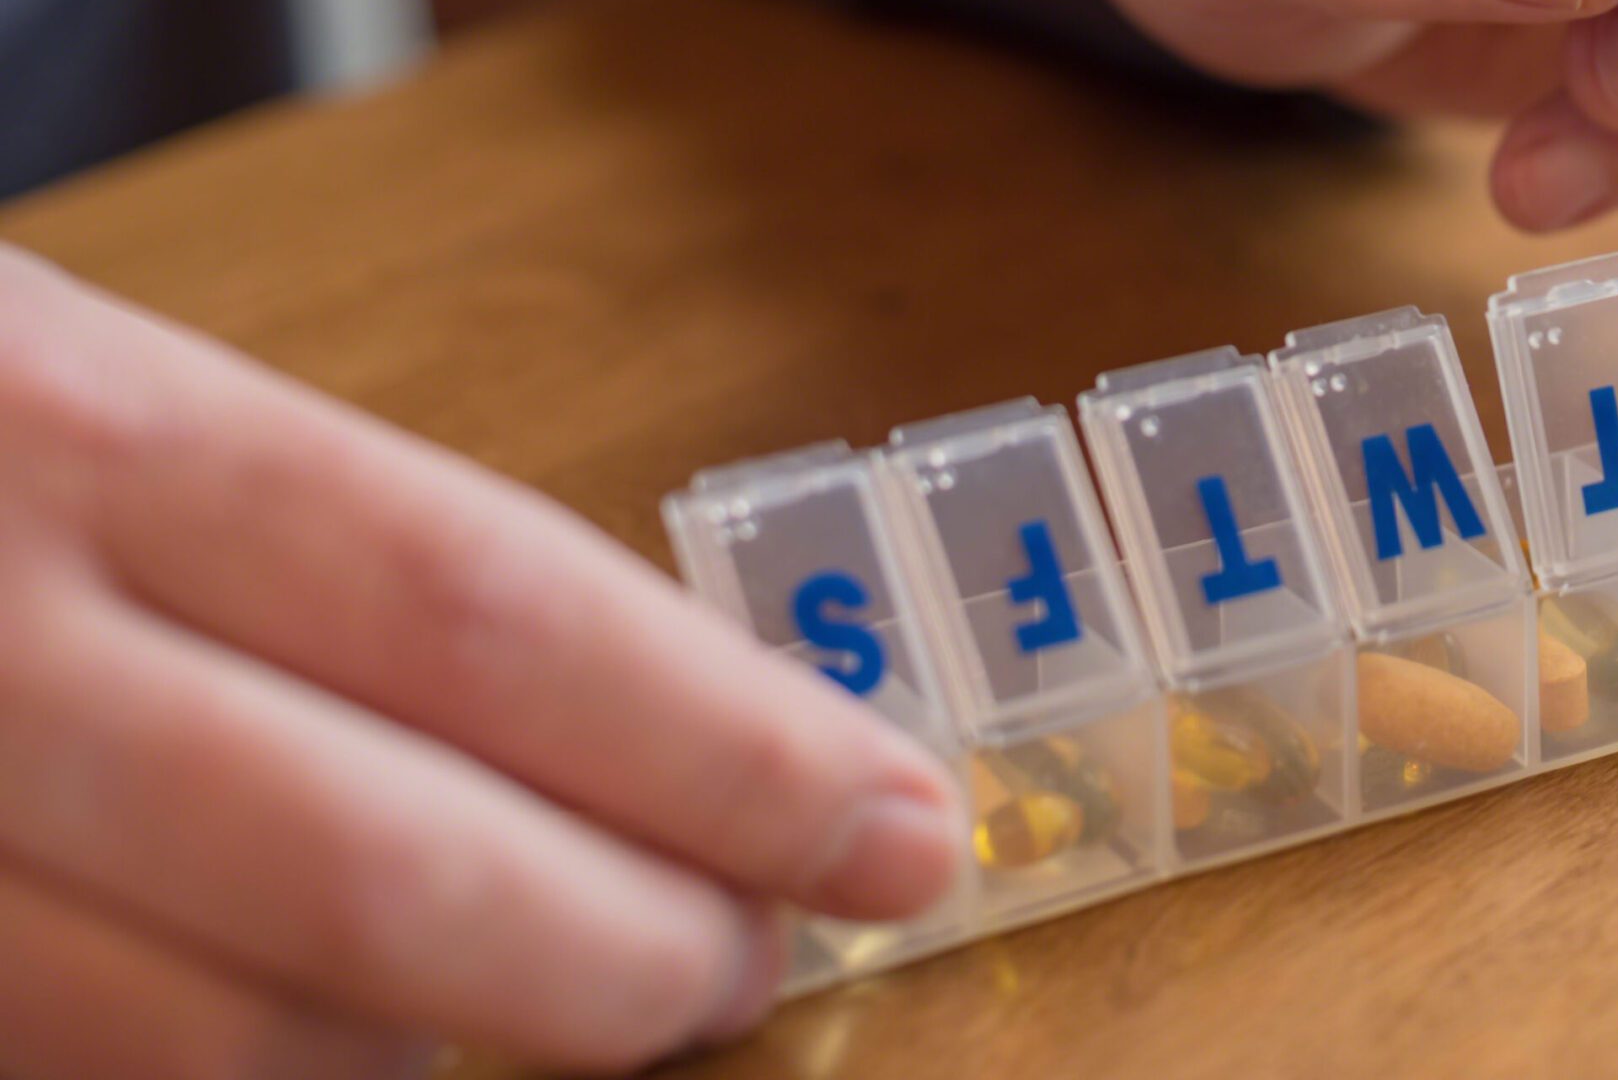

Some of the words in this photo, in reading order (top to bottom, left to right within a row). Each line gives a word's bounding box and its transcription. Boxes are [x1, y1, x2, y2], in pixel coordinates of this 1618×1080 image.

[1196, 475, 1281, 605] T
[1361, 423, 1486, 561] W
[791, 569, 886, 697] S
[1007, 519, 1081, 653] F
